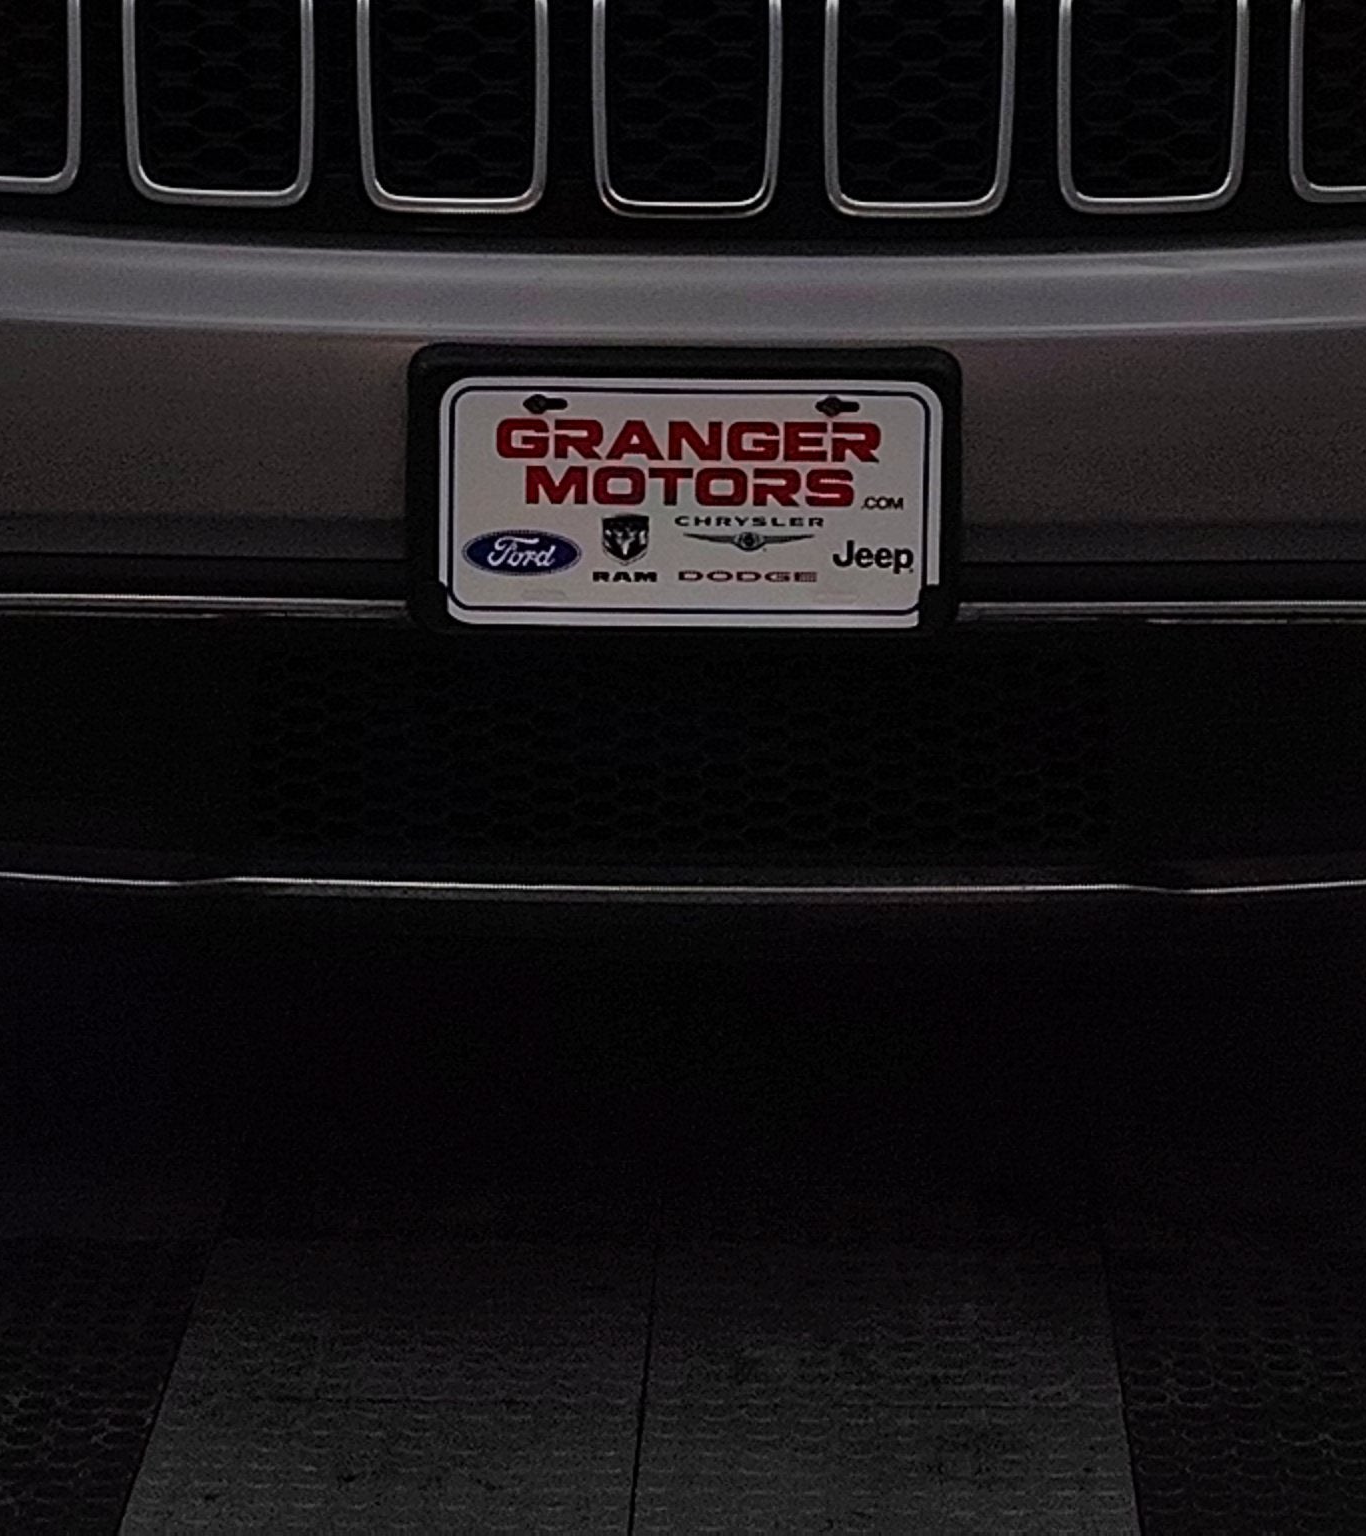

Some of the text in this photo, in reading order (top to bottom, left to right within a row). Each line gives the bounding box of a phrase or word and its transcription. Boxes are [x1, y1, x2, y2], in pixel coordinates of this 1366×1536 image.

[495, 418, 882, 463] GRANGER
[524, 465, 904, 511] MOTORS .COM
[674, 515, 825, 528] CHRYSLER
[486, 535, 557, 567] Ford
[832, 540, 914, 575] Jeep
[592, 571, 658, 583] RAM
[678, 571, 818, 583] DODGE
